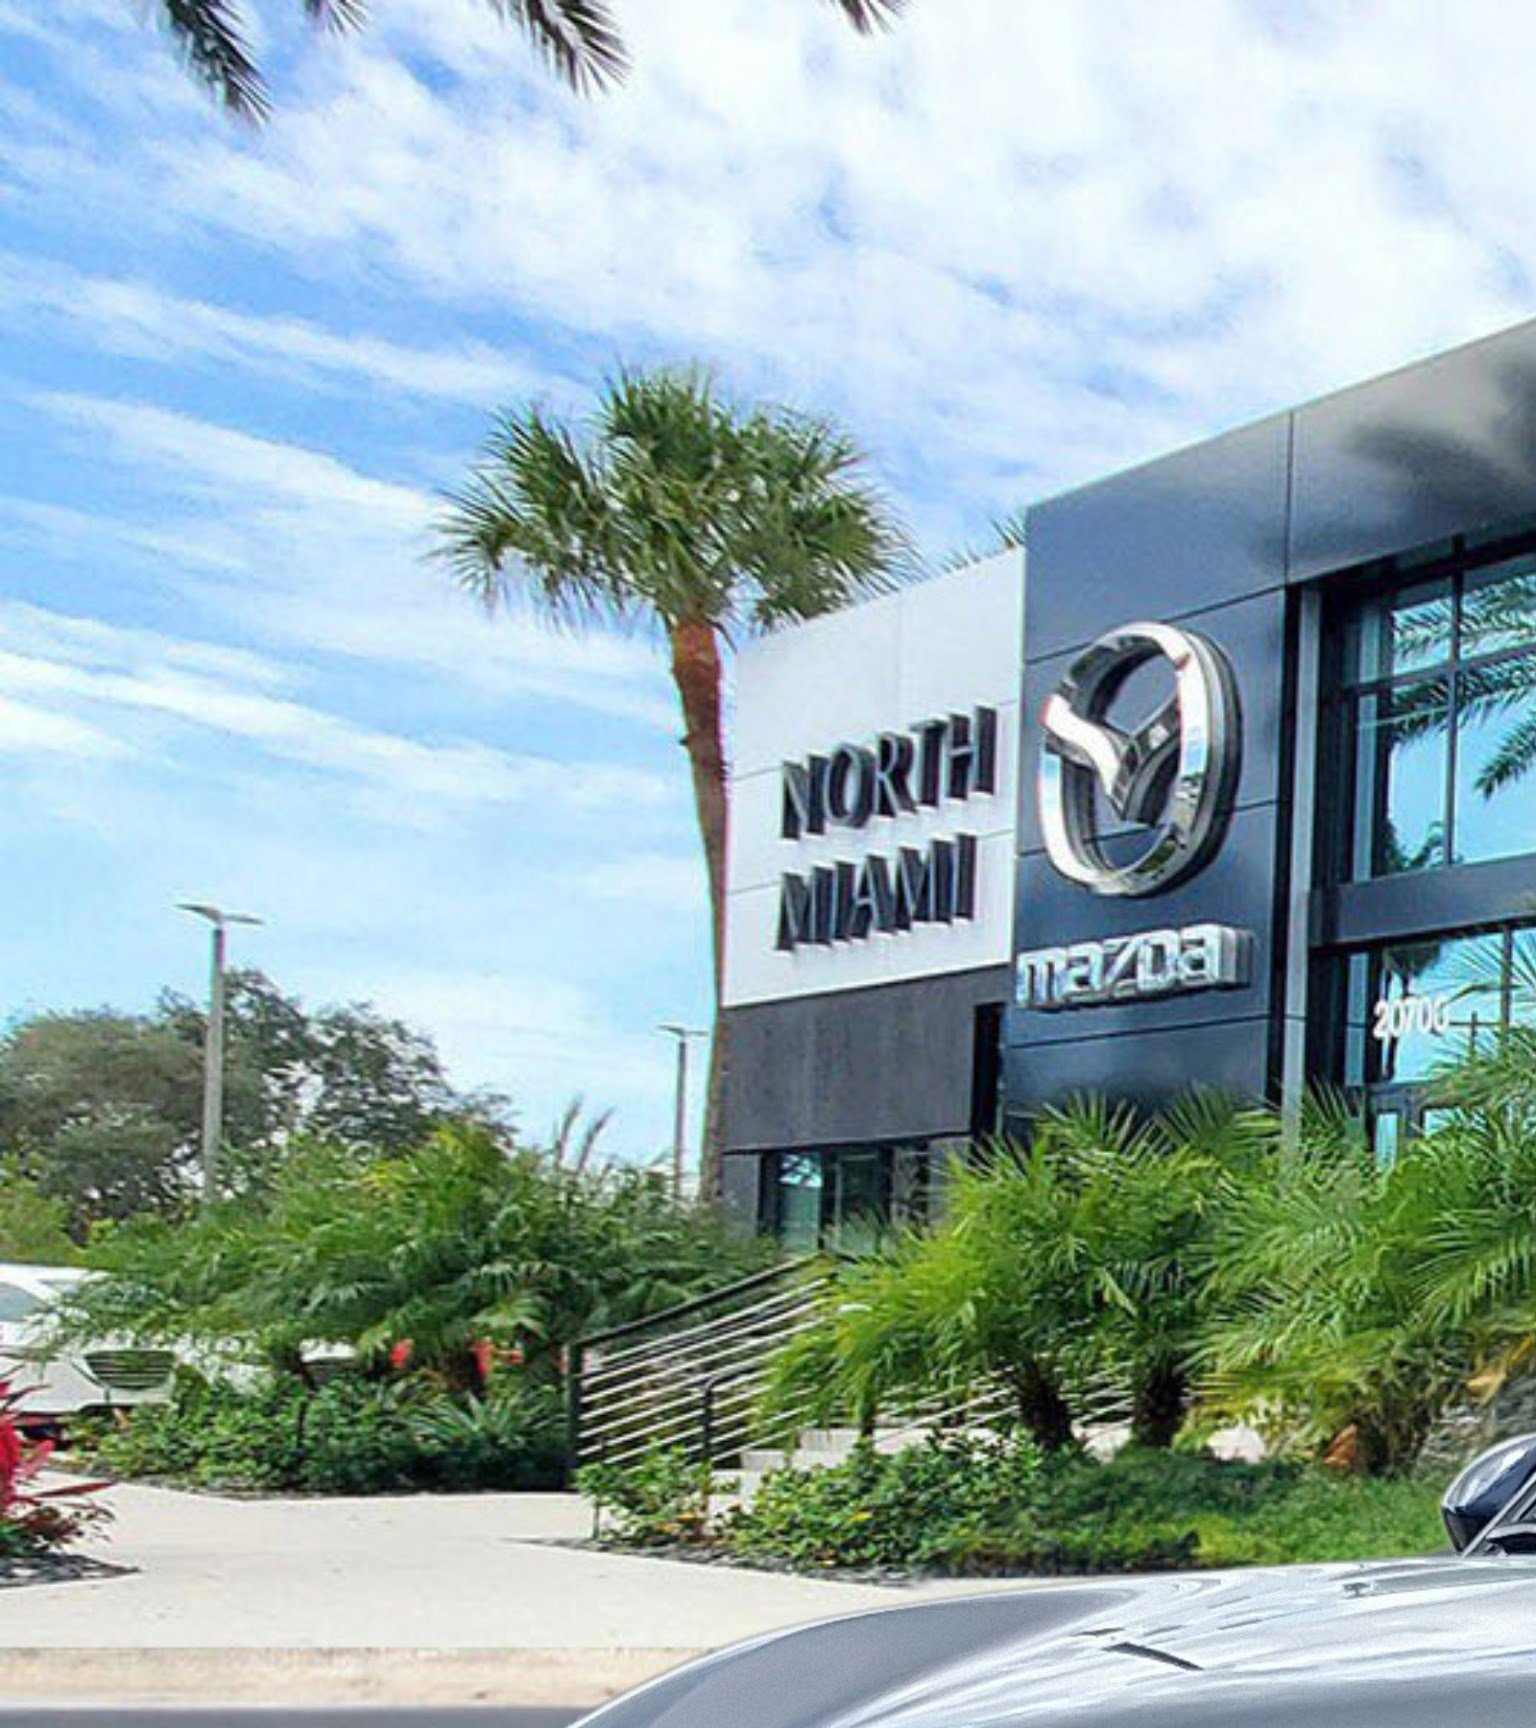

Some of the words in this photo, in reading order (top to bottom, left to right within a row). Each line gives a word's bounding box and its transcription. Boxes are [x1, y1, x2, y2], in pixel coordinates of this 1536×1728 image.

[781, 705, 997, 840] NORTH
[774, 833, 977, 953] MIAMI
[1373, 993, 1449, 1038] 20700
